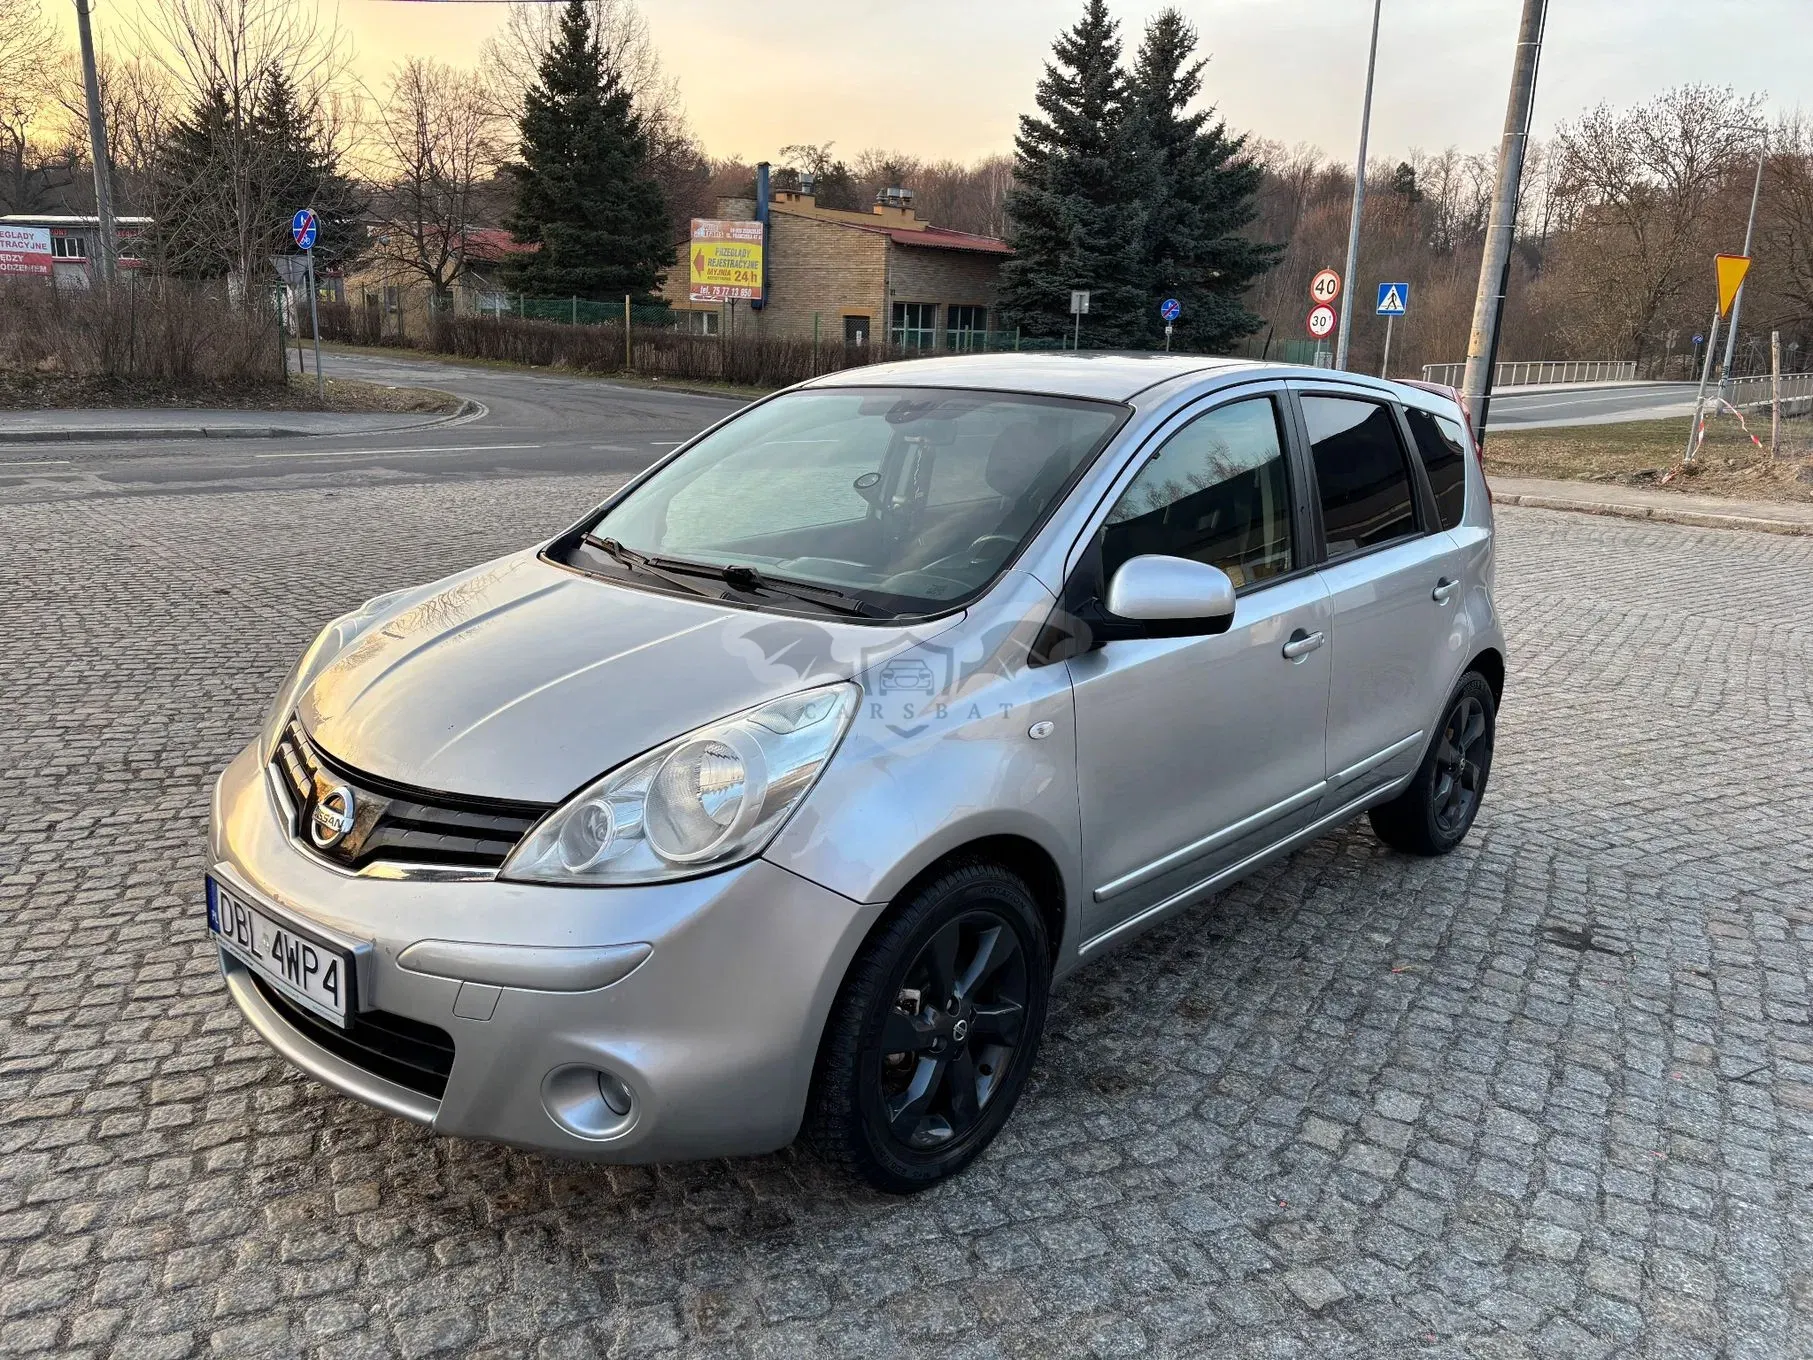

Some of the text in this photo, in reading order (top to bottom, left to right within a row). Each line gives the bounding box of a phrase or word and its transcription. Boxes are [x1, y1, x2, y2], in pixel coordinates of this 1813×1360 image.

[712, 286, 721, 295] 75
[721, 287, 730, 296] 77
[1315, 279, 1336, 295] 40
[1312, 315, 1327, 327] 30
[220, 889, 338, 1007] DBL 4WP4
